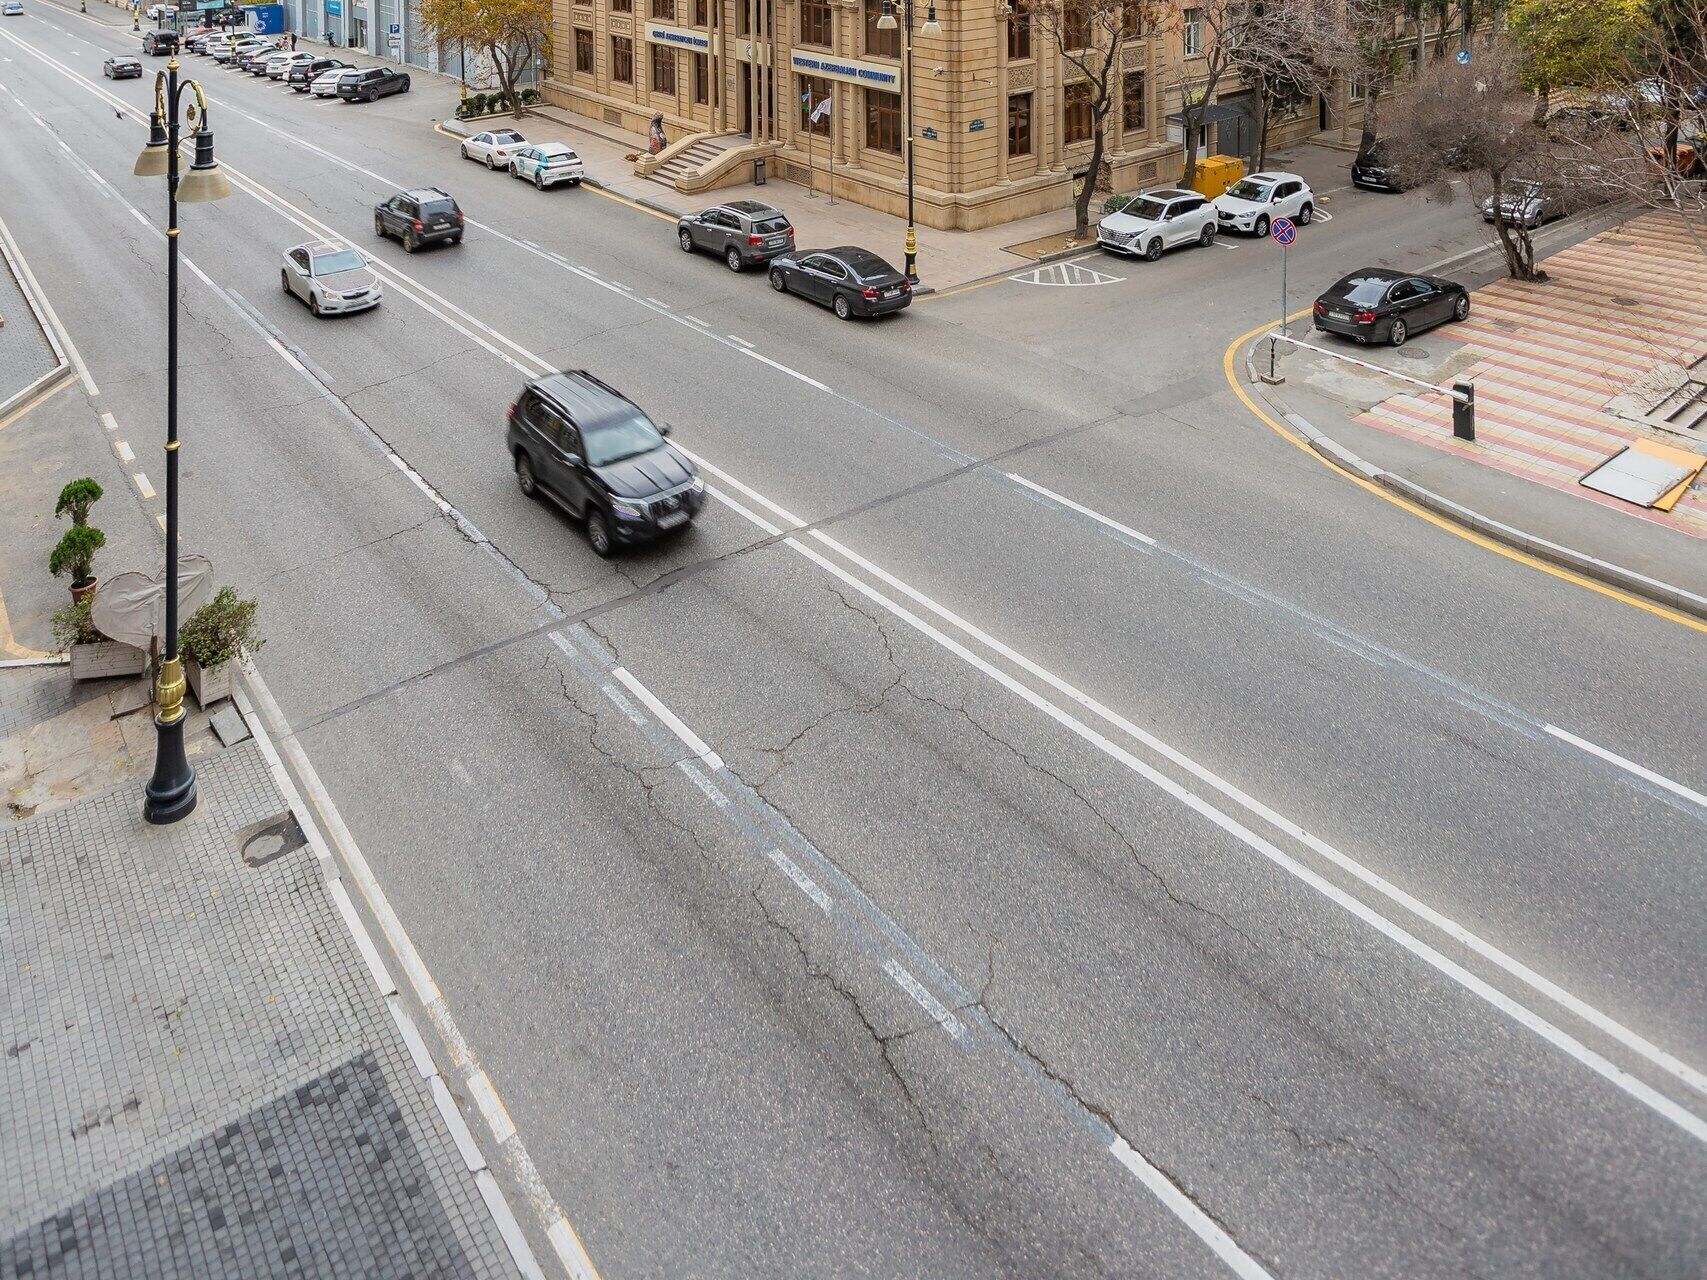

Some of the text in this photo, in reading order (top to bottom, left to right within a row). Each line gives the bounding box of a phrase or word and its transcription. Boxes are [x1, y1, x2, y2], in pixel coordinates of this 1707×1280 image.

[793, 56, 896, 84] WESTERN AZERBAIJAN COMMUNITY
